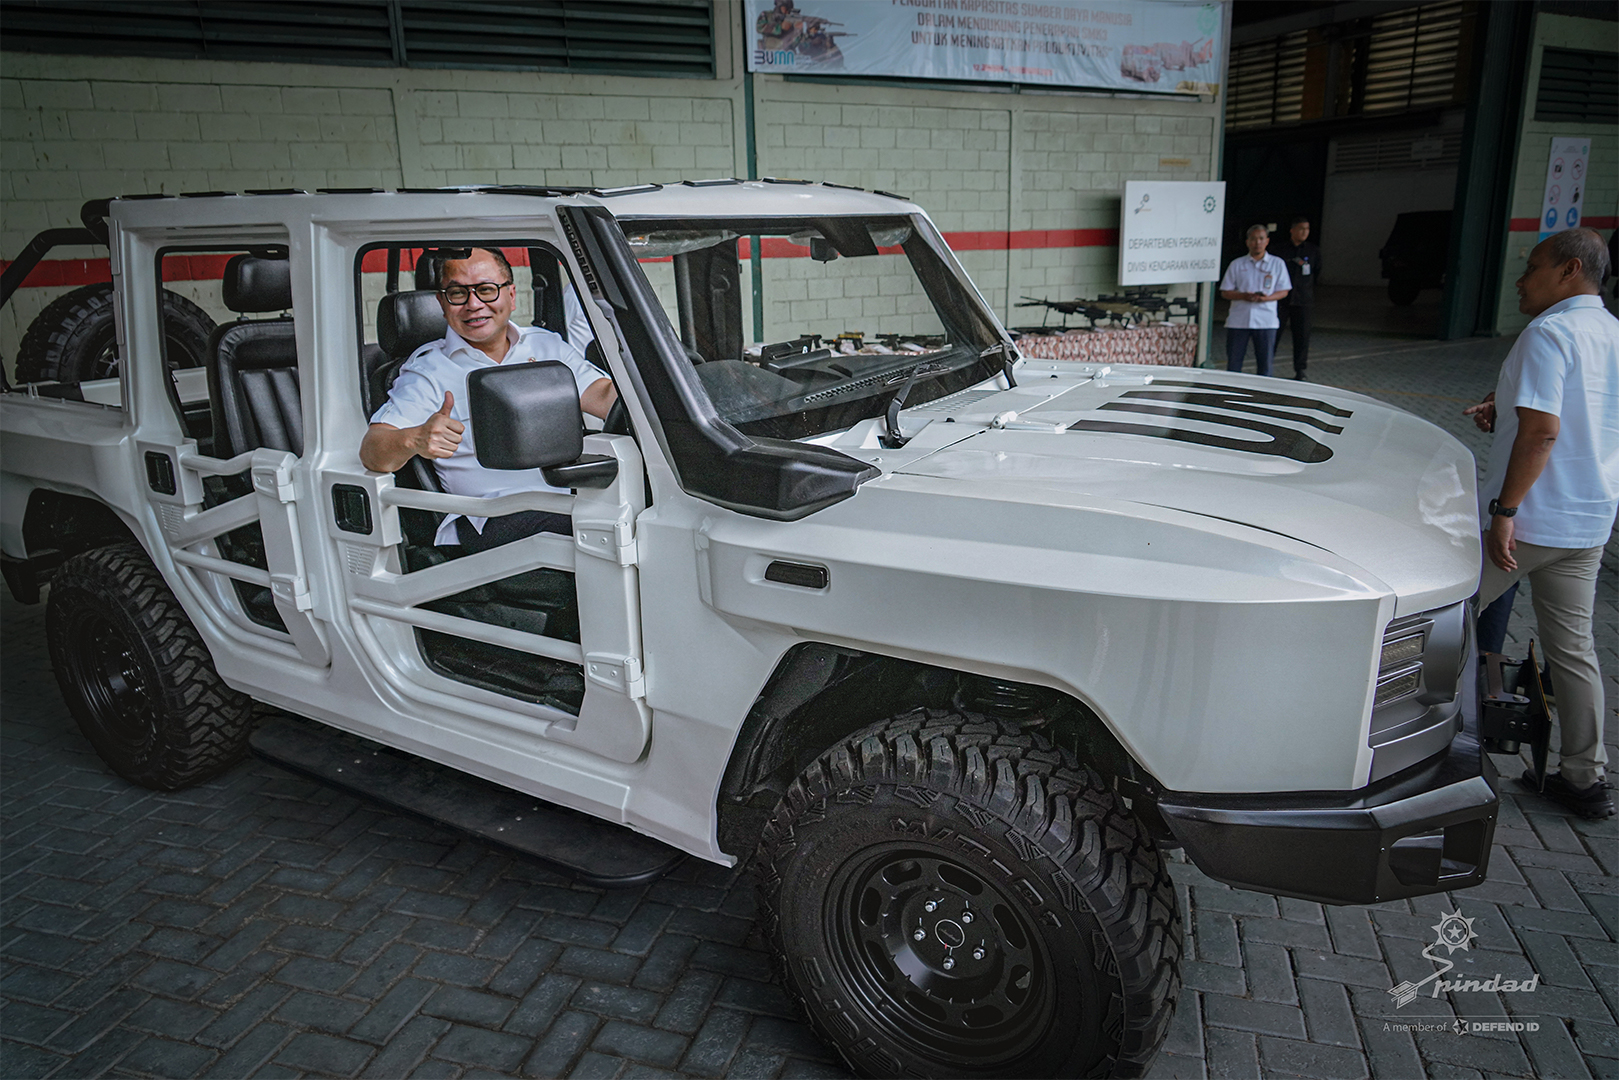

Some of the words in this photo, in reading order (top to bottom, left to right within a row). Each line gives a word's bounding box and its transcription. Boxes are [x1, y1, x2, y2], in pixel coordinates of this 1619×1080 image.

[960, 0, 1019, 15] KAPASITAS
[1022, 2, 1061, 19] SUMBER
[1063, 6, 1089, 22] DAYA
[1091, 9, 1133, 26] MANUSIA
[917, 12, 955, 28] DALAM
[957, 16, 1021, 34] MENDUKUNG
[1023, 21, 1080, 39] PENERAPAN
[911, 30, 947, 46] UNTUK
[950, 33, 1031, 52] MENINGKATKAN
[1128, 237, 1178, 250] DEPARTEMEN
[1179, 236, 1218, 249] PERAKITAN
[1127, 260, 1147, 273] DIVISI
[1148, 259, 1189, 272] KENDARAAN
[1189, 258, 1216, 270] KHUSUS
